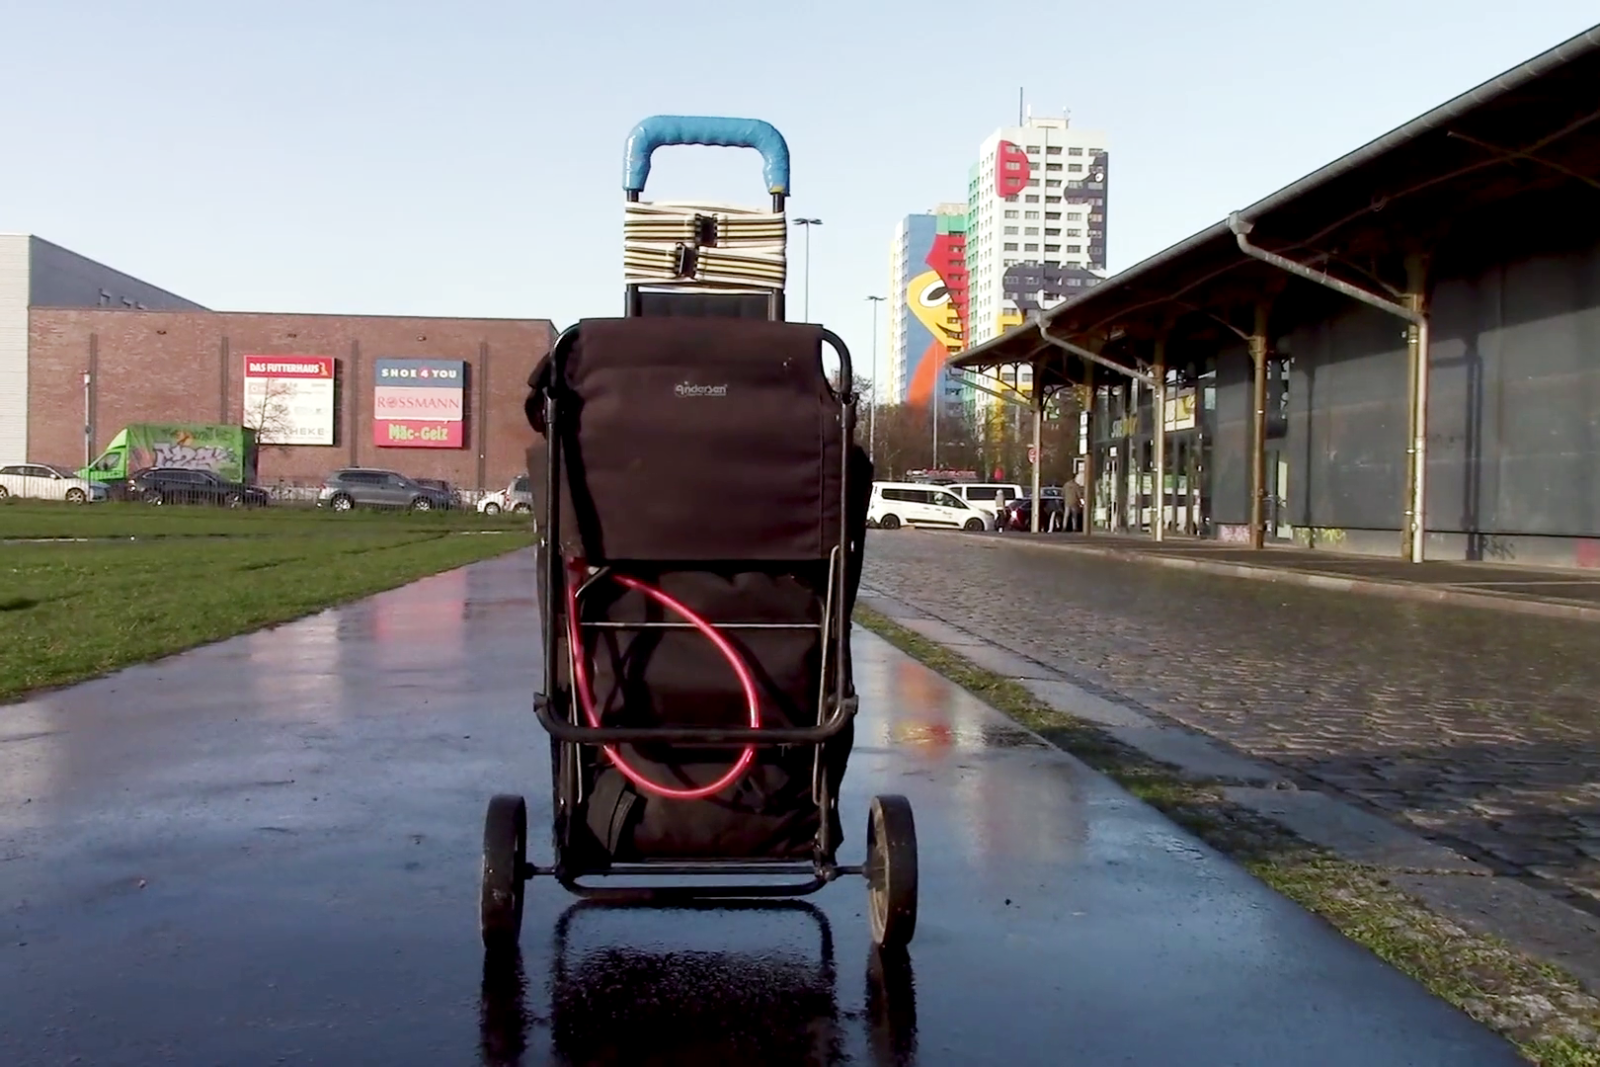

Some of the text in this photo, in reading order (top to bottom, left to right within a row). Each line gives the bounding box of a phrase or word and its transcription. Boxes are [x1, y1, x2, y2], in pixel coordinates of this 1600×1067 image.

[249, 363, 319, 374] DAS FUTTERHAUS
[381, 368, 457, 378] SHOE 4 YOU
[377, 396, 459, 409] ROSSMANN
